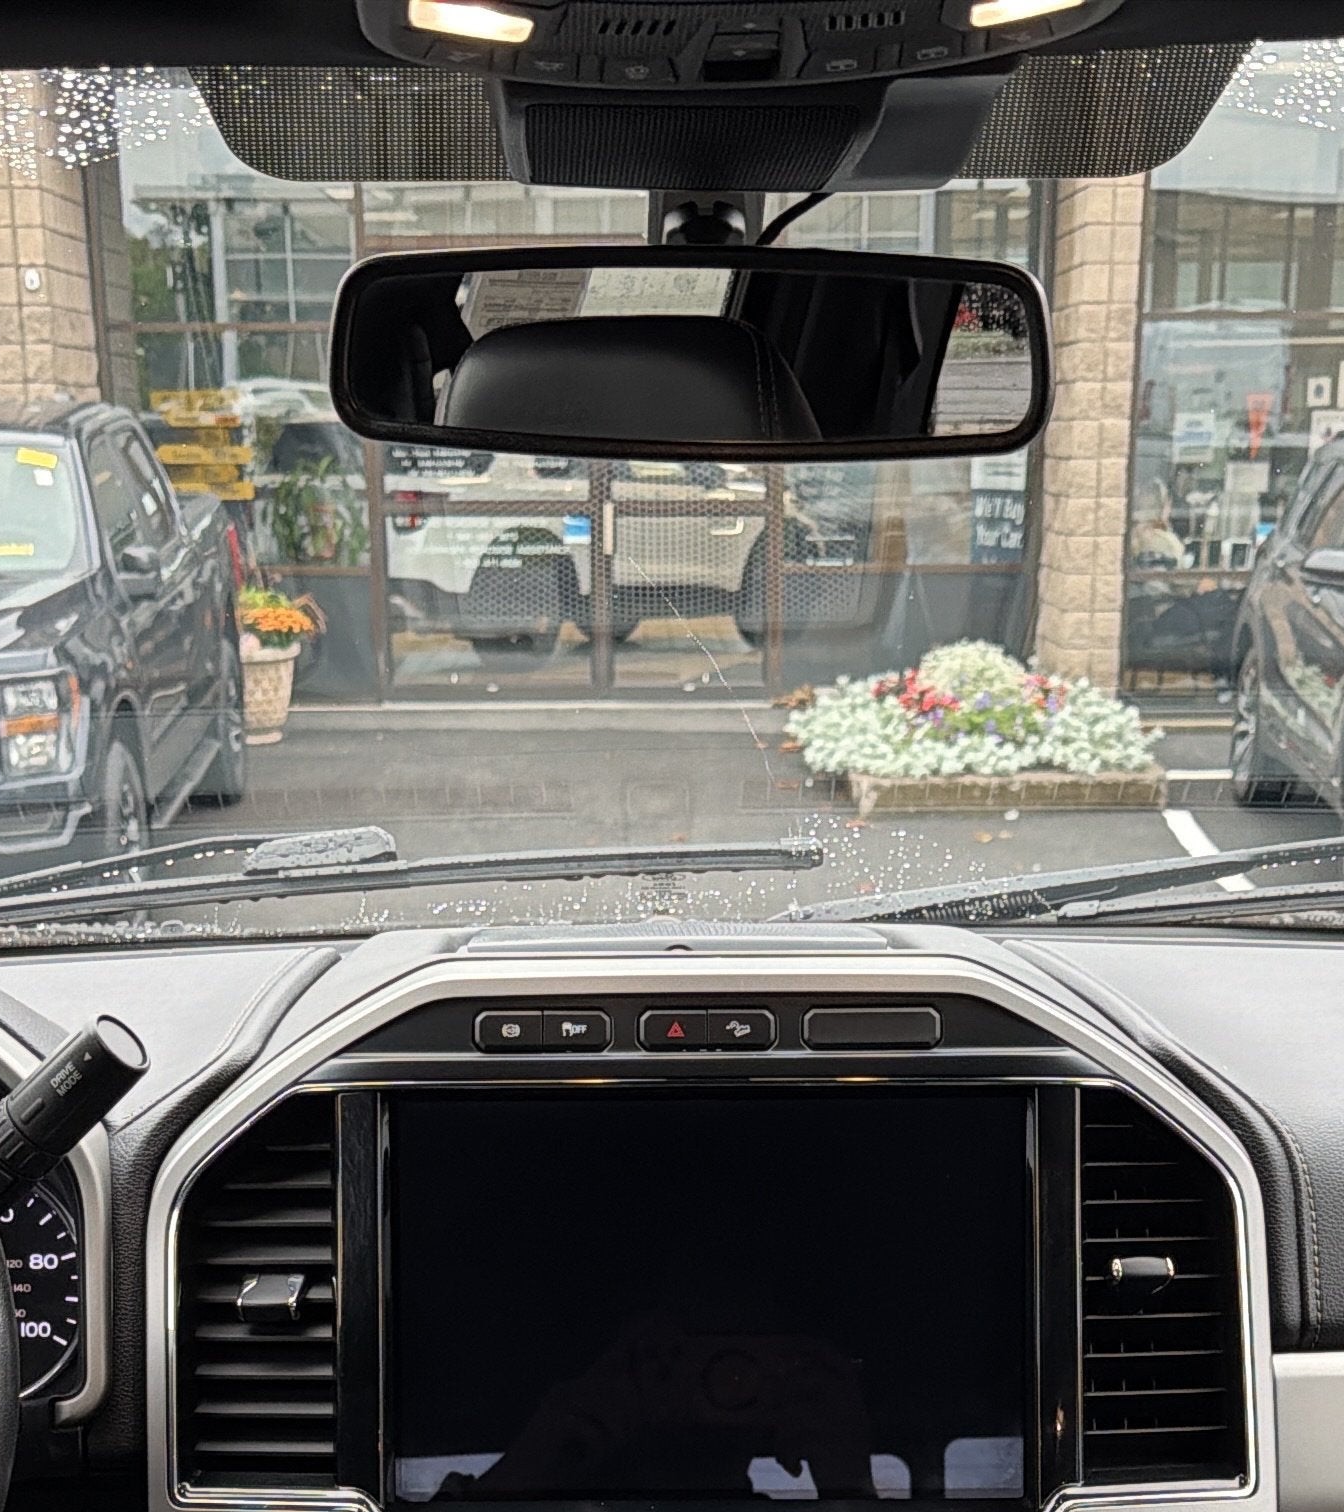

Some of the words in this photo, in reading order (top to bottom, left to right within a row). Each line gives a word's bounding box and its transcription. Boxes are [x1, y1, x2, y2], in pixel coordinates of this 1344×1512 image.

[49, 1060, 76, 1088] DRIVE
[55, 1070, 83, 1097] MODE
[28, 1253, 58, 1270] 80
[13, 1282, 32, 1293] 140
[19, 1321, 51, 1338] 100
